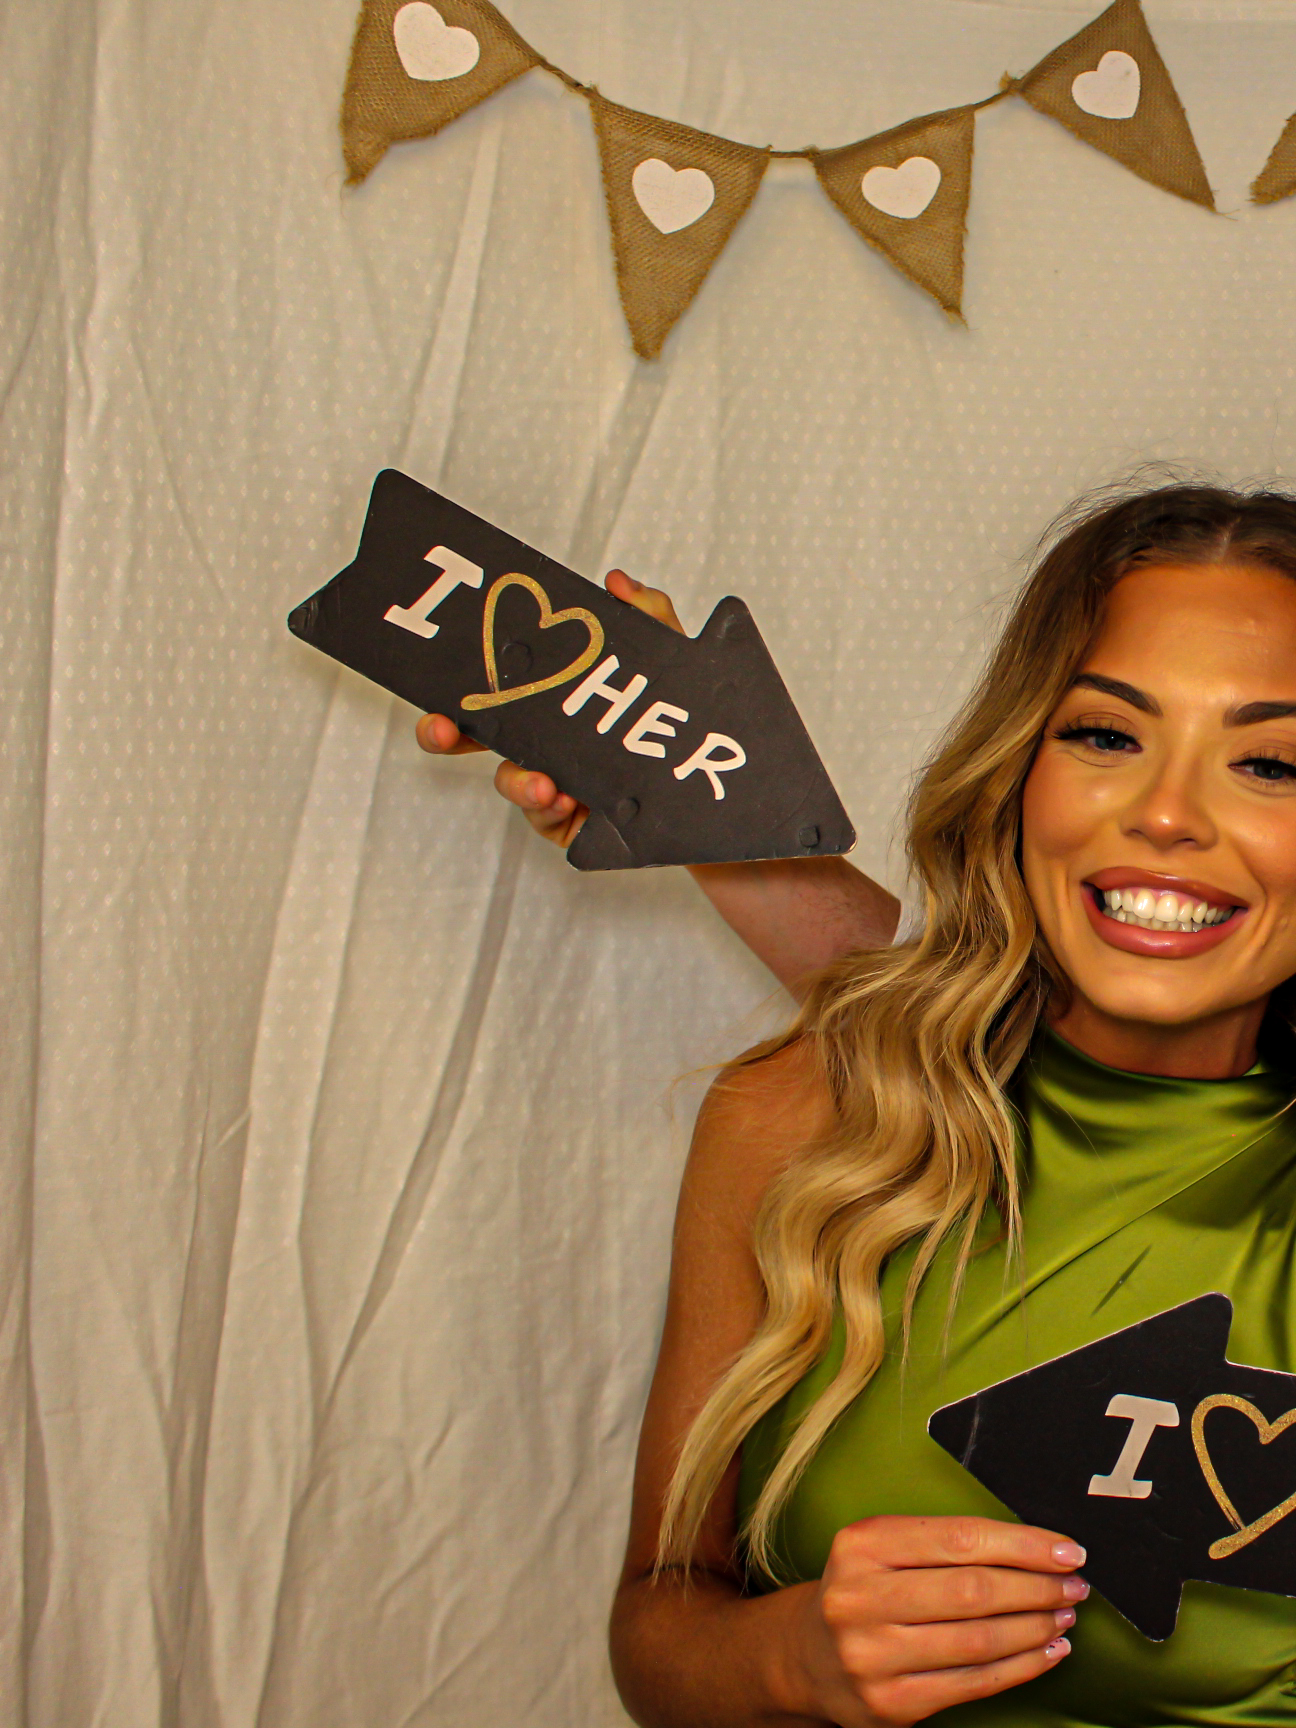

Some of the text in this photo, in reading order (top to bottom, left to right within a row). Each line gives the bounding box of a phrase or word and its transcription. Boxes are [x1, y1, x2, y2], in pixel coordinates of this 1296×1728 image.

[383, 545, 747, 801] I HER
[1087, 1393, 1180, 1499] I
